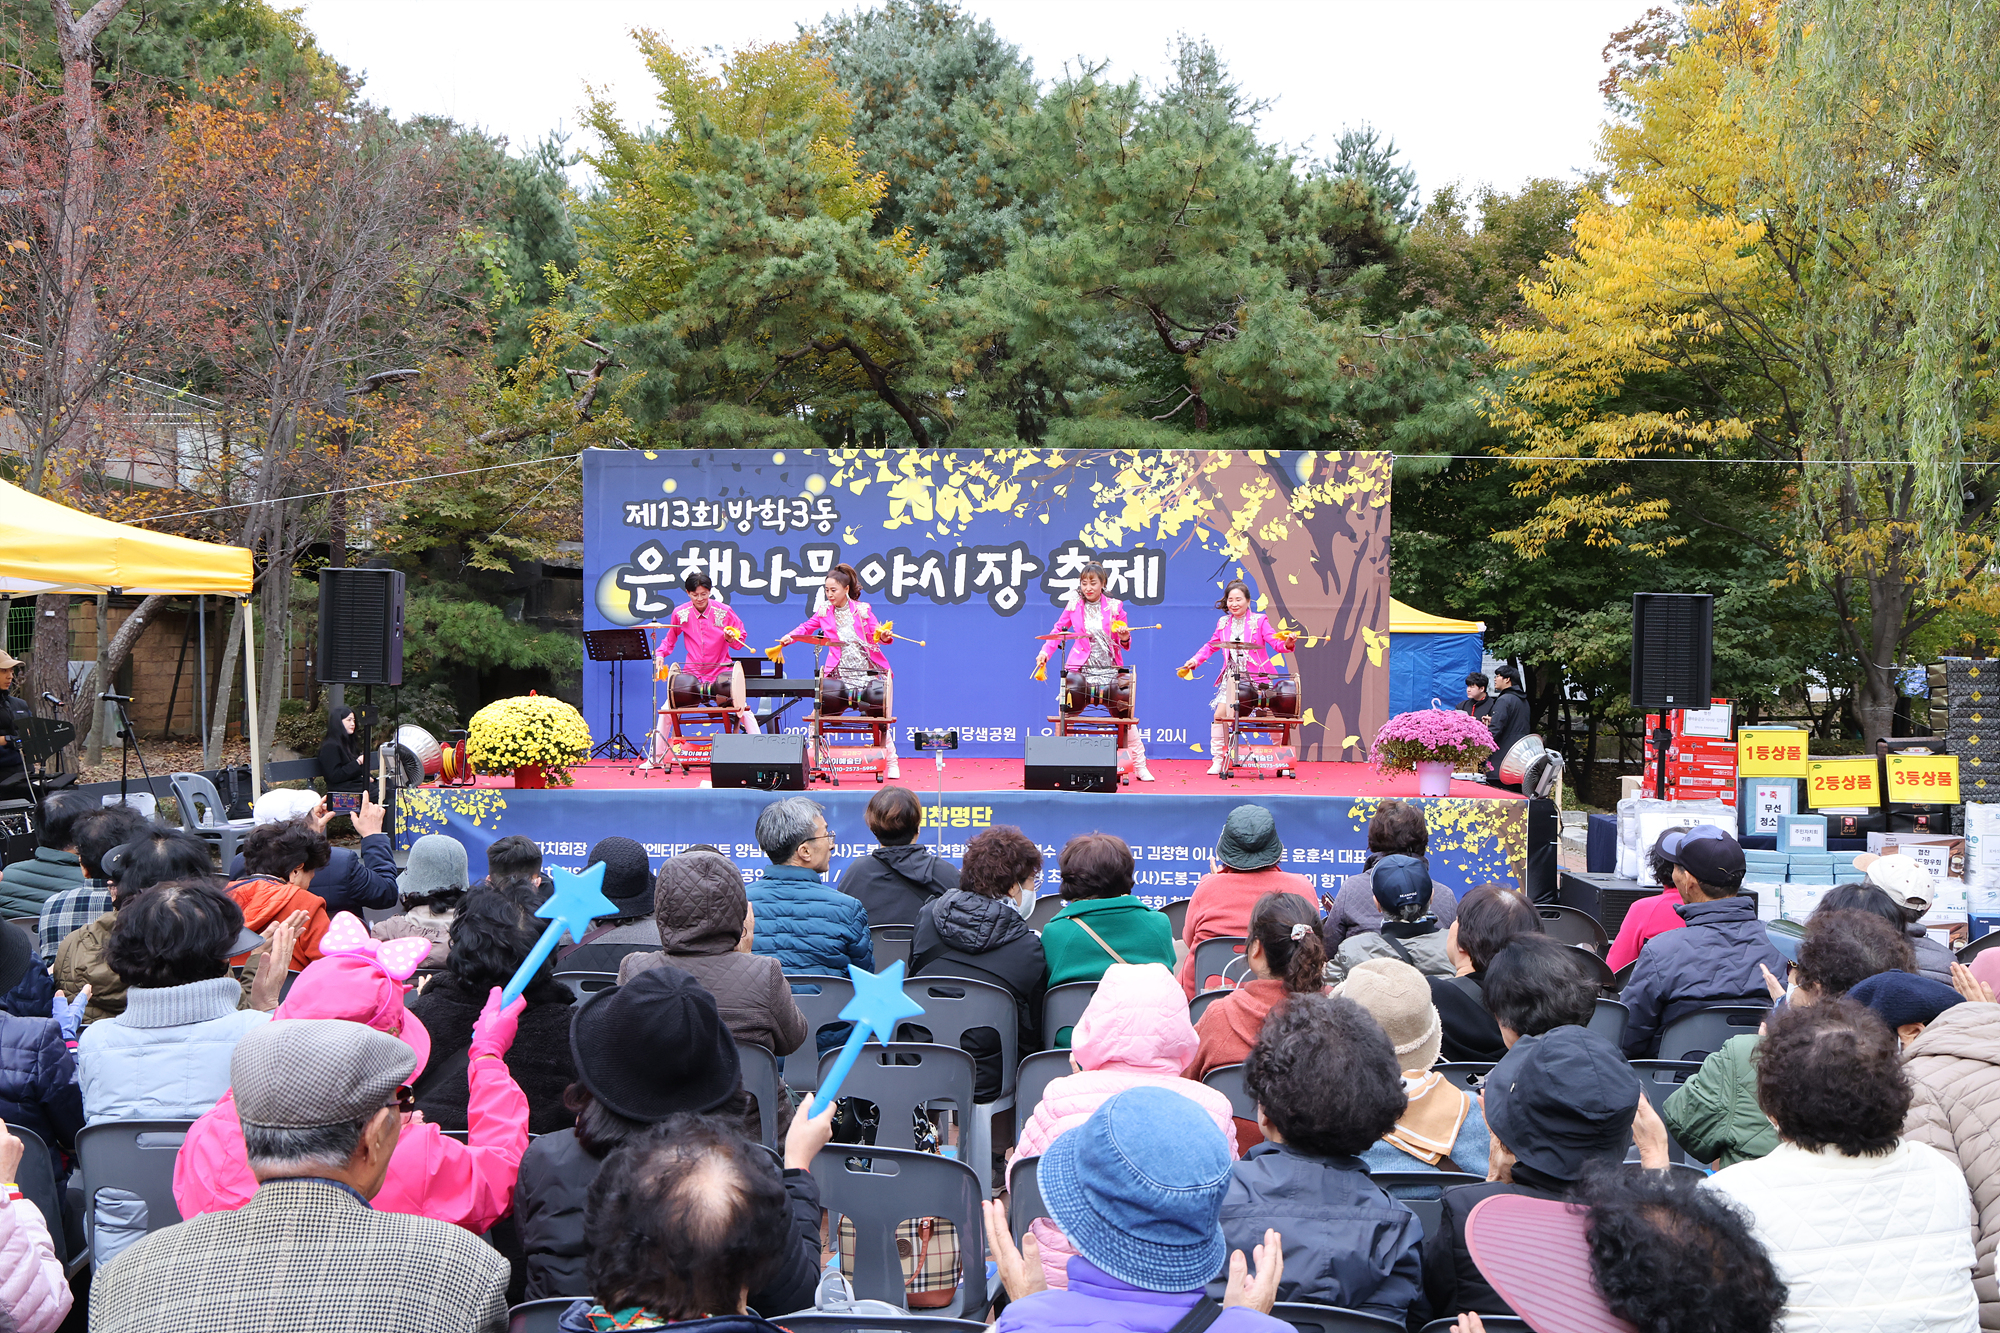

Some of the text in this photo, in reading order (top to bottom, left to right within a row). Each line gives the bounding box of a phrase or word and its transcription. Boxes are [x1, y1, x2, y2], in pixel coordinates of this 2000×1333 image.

[626, 499, 838, 533] 제13회 방학3동
[860, 548, 1037, 609] 야시장
[1156, 728, 1187, 743] 20시
[1746, 746, 1802, 761] 1등상품
[1814, 775, 1872, 791] 2등상품
[1895, 771, 1953, 787] 3등상품
[1764, 804, 1782, 814] 무선
[1147, 846, 1189, 862] 김창현
[1292, 848, 1335, 864] 윤훈석
[1338, 849, 1367, 865] 대표
